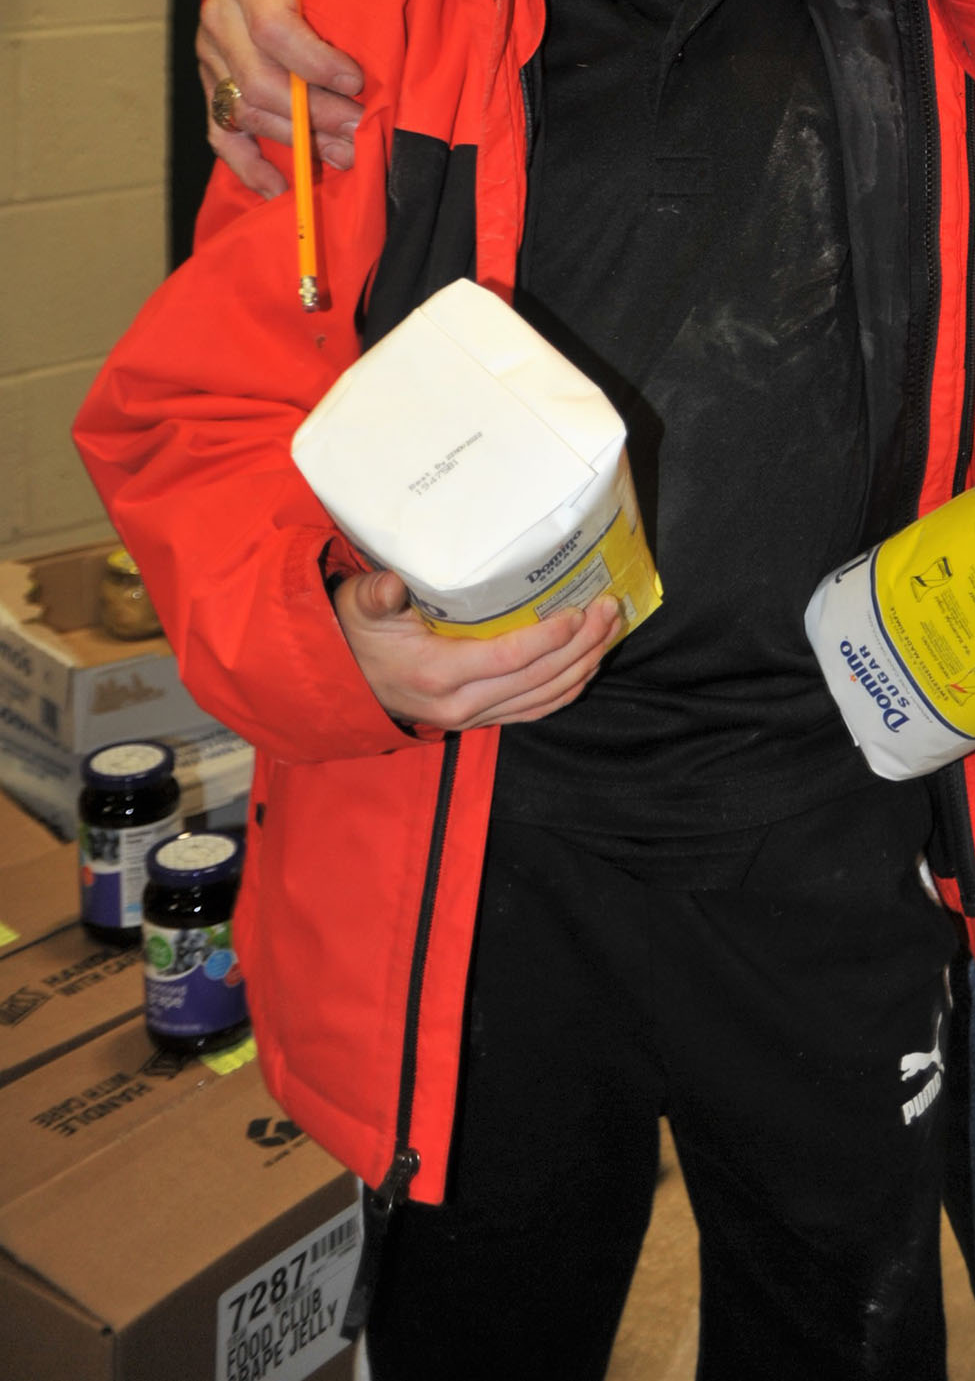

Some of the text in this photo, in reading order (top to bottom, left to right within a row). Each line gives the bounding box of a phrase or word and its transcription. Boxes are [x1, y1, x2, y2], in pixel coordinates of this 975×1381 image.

[525, 530, 582, 583] Domino
[540, 543, 577, 582] SUGAR
[889, 606, 906, 634] SIMPLE
[904, 636, 921, 659] MADE
[840, 640, 910, 733] Domino
[859, 644, 910, 708] SUGAR
[228, 1250, 309, 1334] 7287
[227, 1323, 274, 1379] FOOD
[279, 1287, 323, 1341] CLUB
[288, 1299, 338, 1357] JELLY
